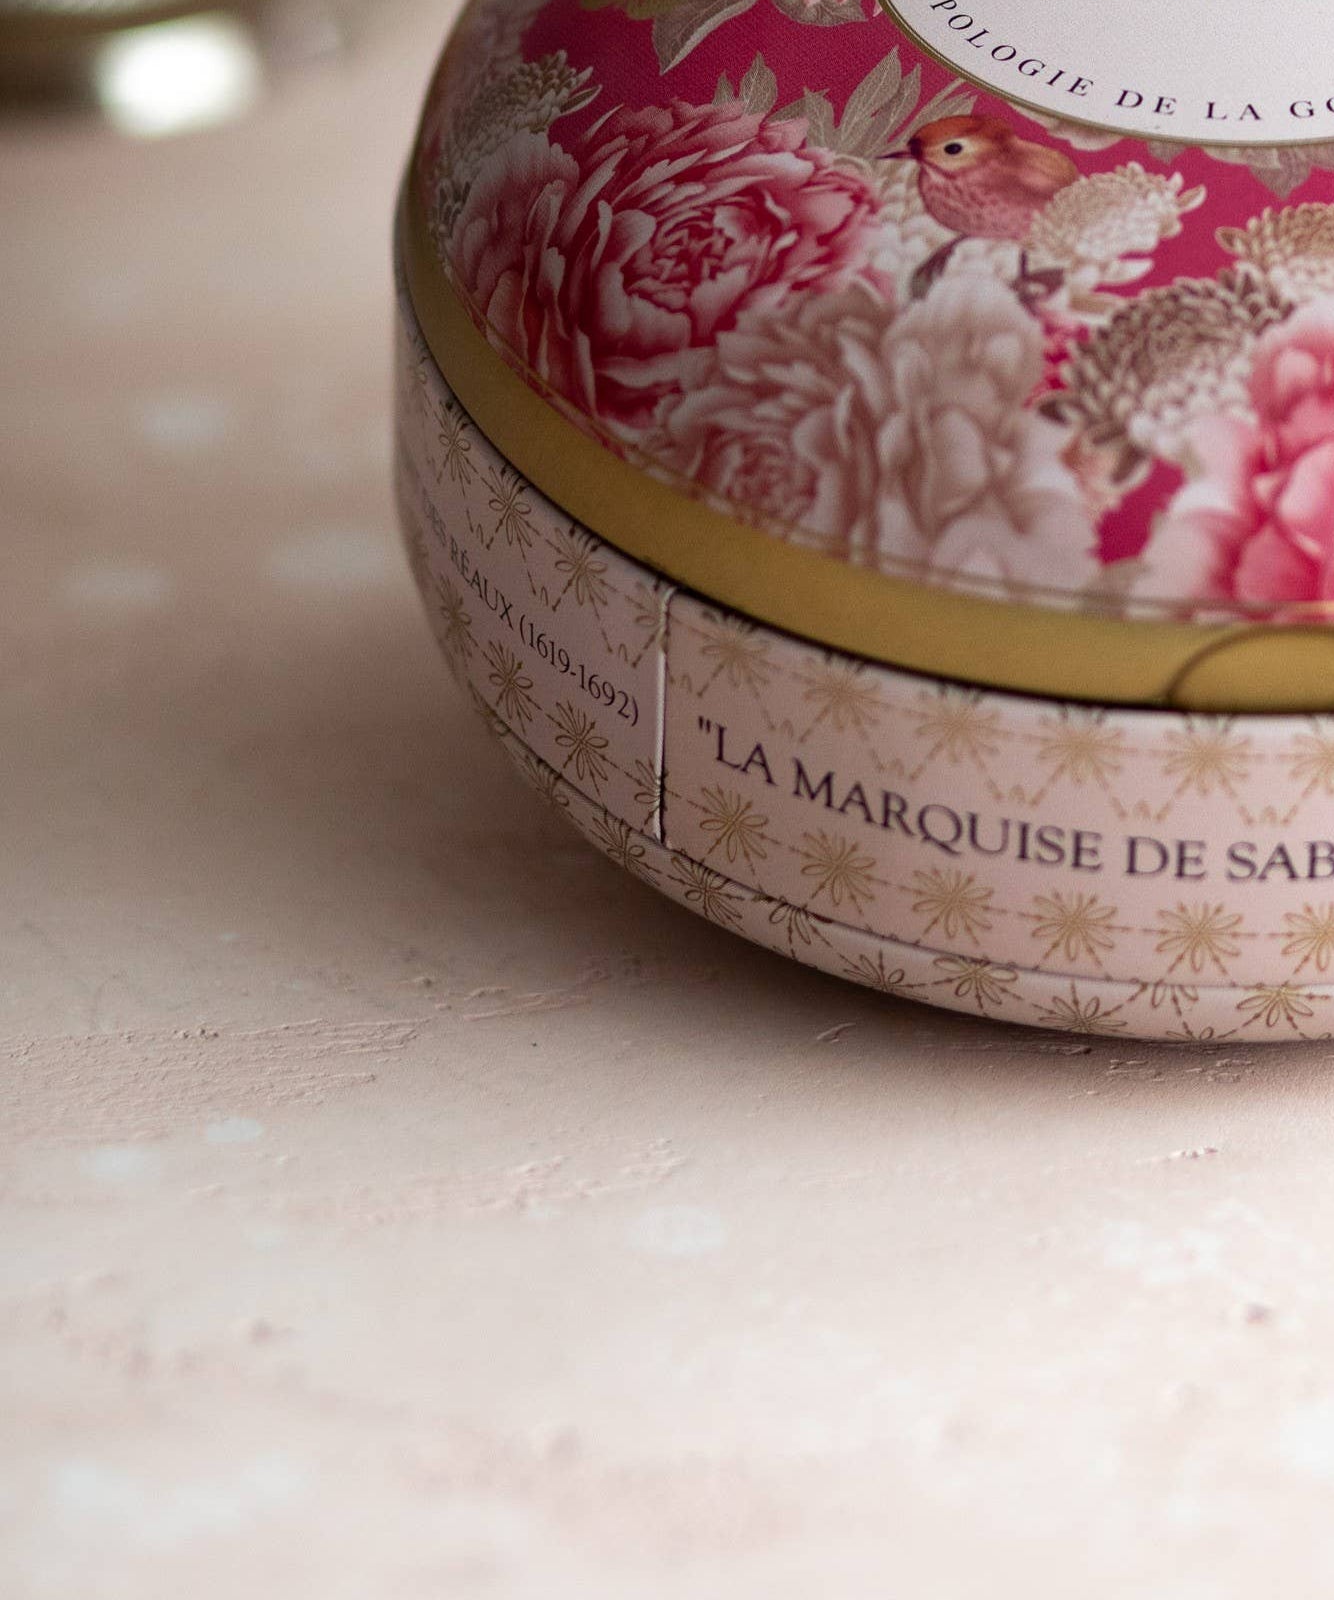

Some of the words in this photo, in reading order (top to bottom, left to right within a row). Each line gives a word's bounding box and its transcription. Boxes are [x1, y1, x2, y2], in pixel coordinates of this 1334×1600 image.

[1114, 88, 1177, 117] DE
[1204, 103, 1263, 122] LA
[451, 537, 514, 630] RÉAUX
[519, 614, 639, 727] (1619-1692)
[698, 715, 777, 787] "LA
[793, 757, 1104, 873] MARQUISE
[1124, 834, 1207, 880] DE
